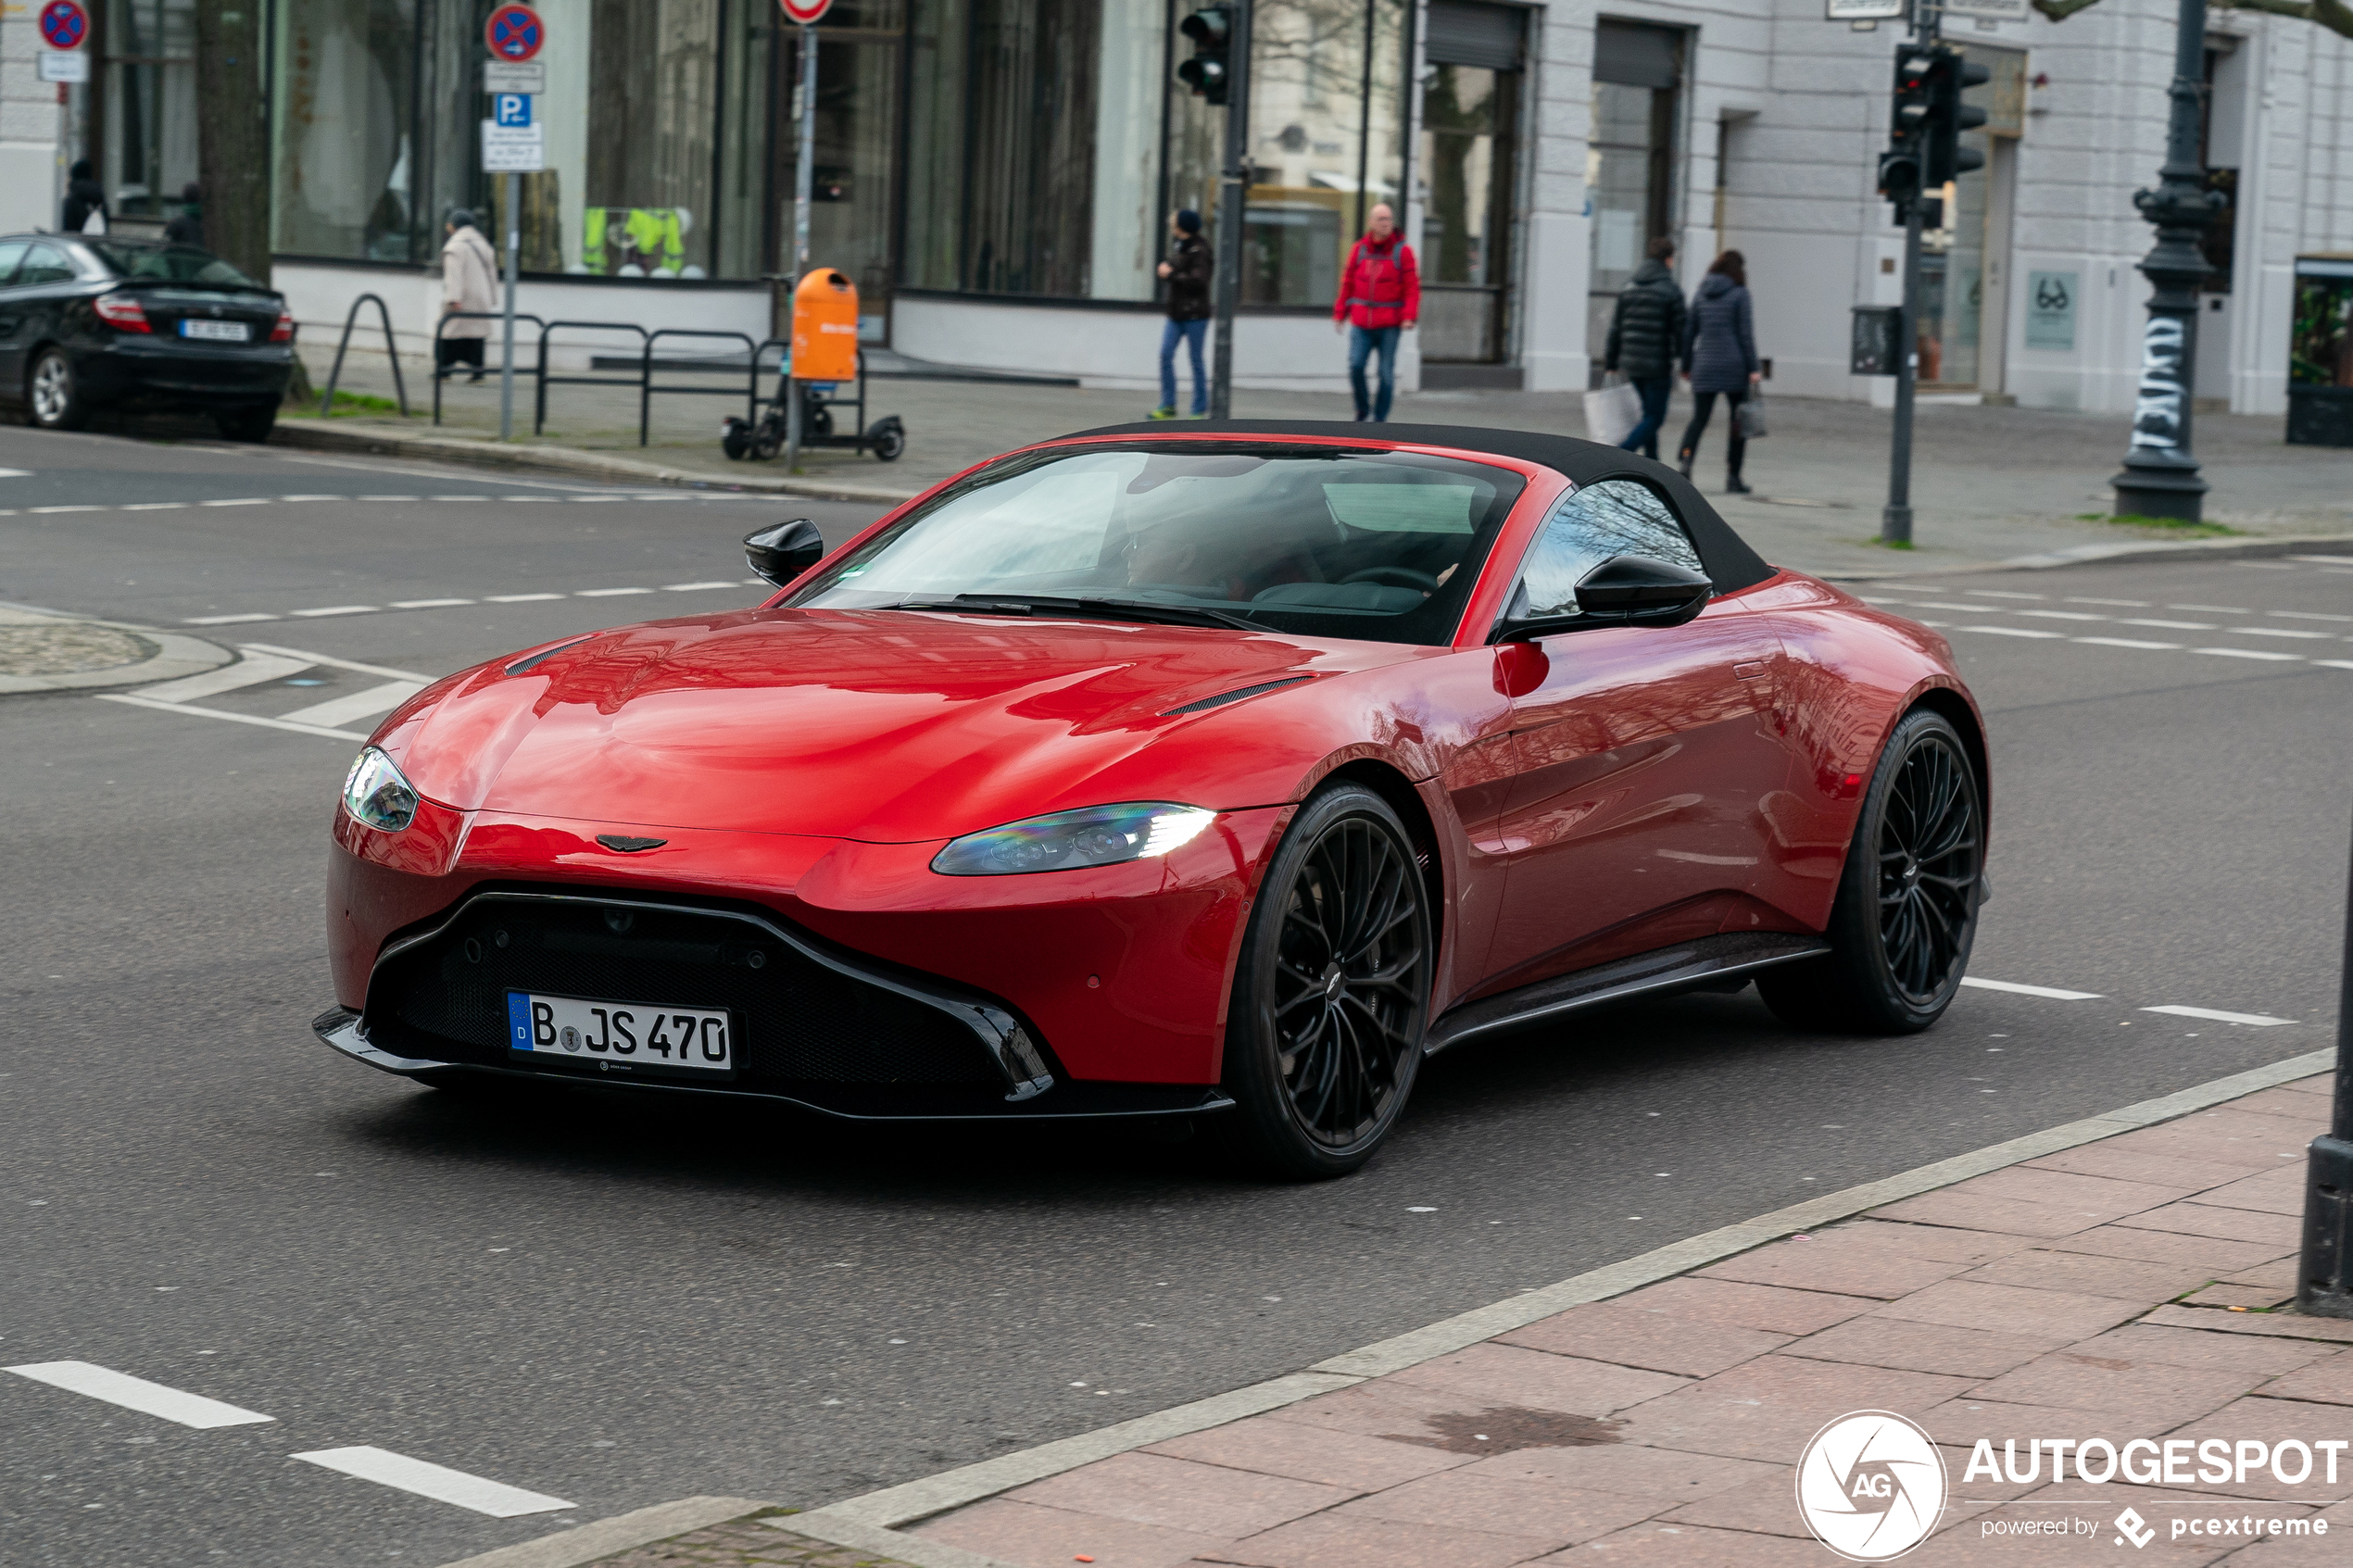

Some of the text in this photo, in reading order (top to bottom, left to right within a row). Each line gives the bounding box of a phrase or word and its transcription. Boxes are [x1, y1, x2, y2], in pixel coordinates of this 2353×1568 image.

[501, 95, 522, 123] P
[517, 1026, 526, 1039] D
[532, 1001, 557, 1046] B
[585, 1008, 637, 1055] JS
[648, 1013, 726, 1062] 470
